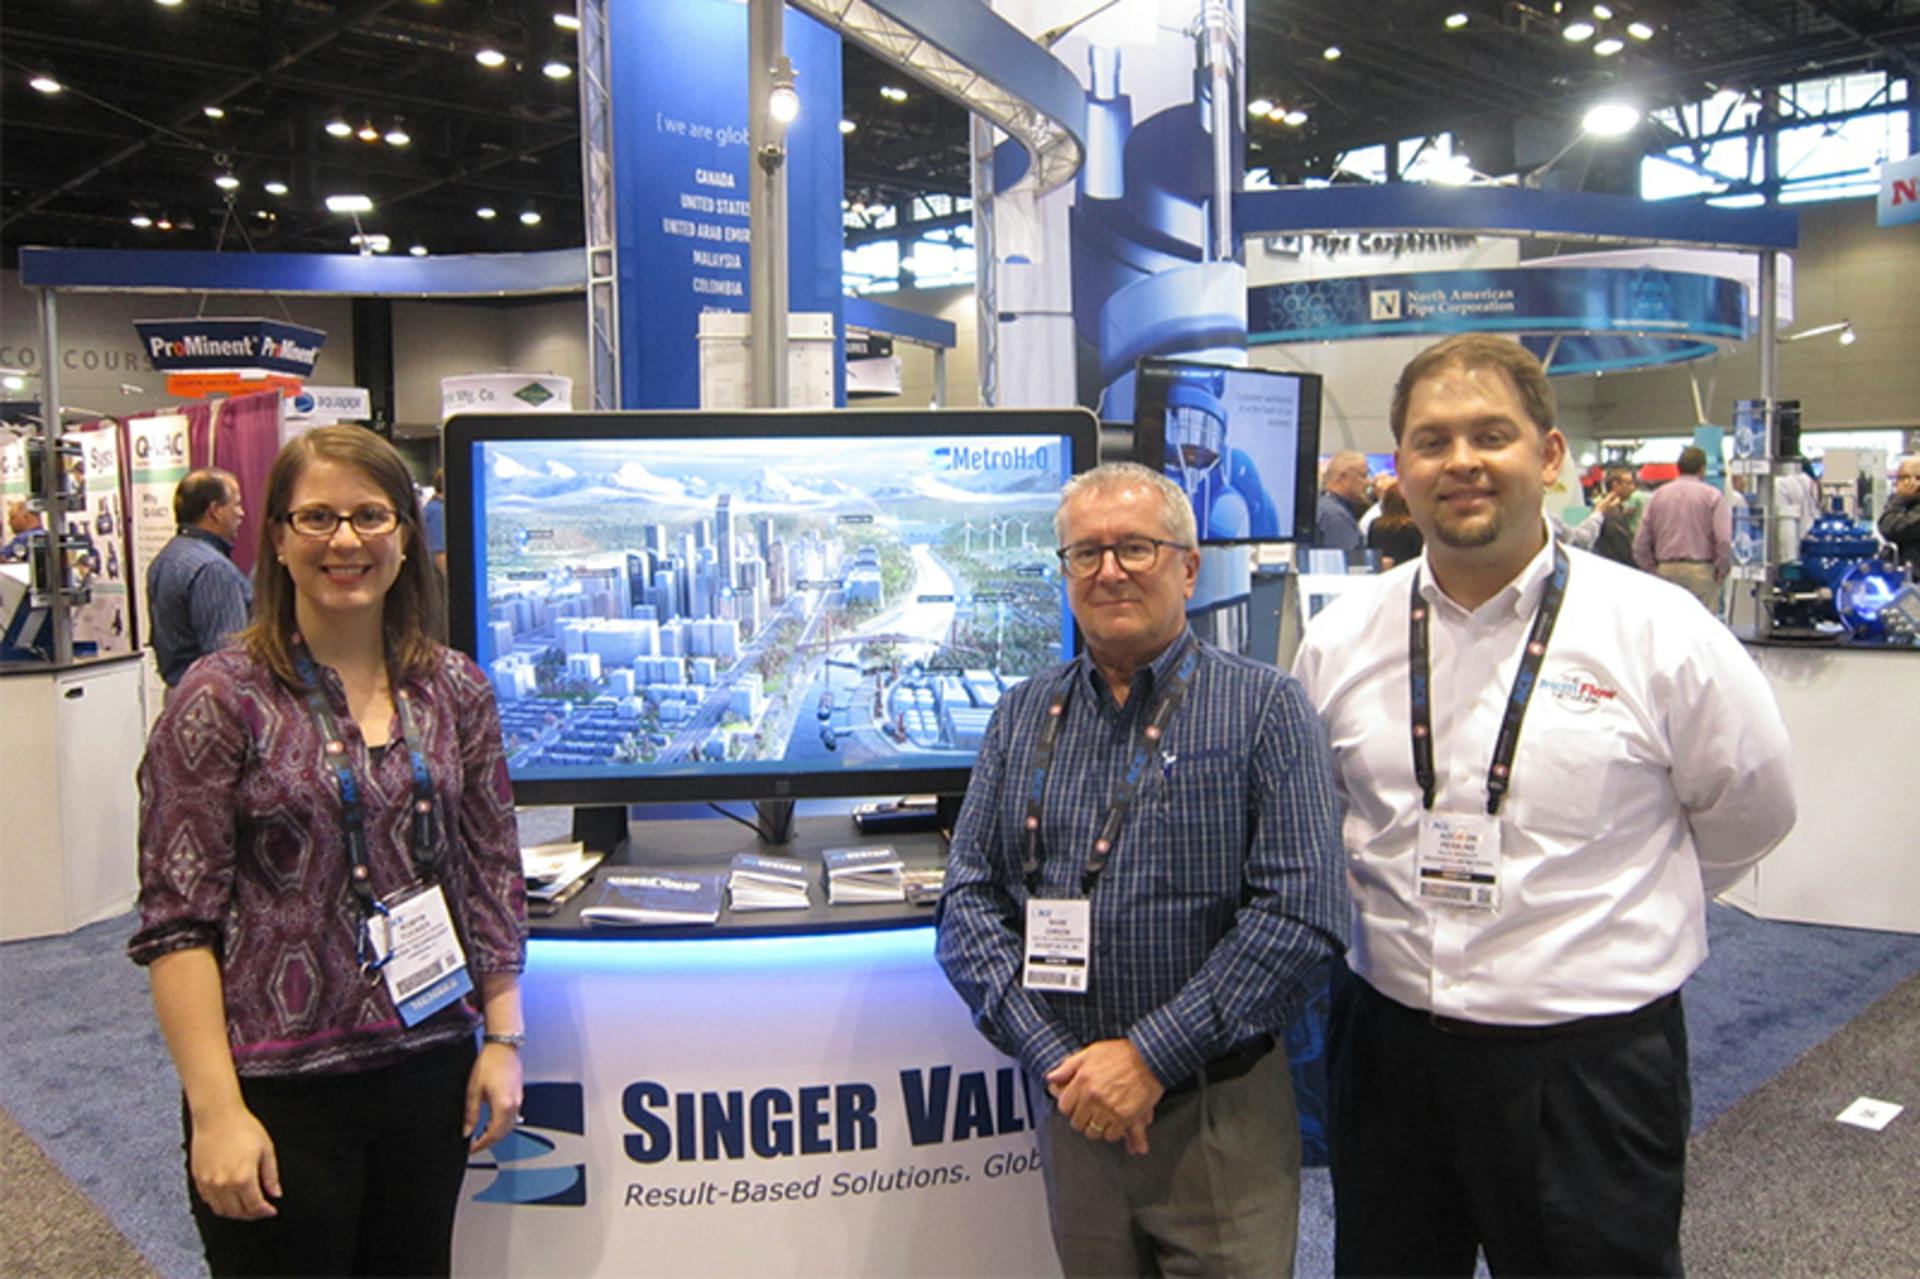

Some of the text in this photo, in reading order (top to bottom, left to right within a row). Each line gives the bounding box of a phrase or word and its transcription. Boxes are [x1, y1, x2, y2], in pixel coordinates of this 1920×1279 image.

[665, 118, 687, 136] we
[688, 123, 713, 141] are
[695, 168, 736, 188] CANADA
[680, 193, 714, 213] UNITED
[663, 217, 696, 237] UNITED
[698, 223, 722, 240] ARAB
[693, 249, 742, 269] MALAYSIA
[693, 277, 743, 296] COLOMBIA
[1407, 291, 1445, 302] North
[1450, 288, 1514, 301] American
[1407, 299, 1515, 317] Pipe Corporation
[621, 1080, 878, 1164] SINGER
[624, 1175, 821, 1207] Result-Based
[831, 1165, 971, 1197] Solutions.
